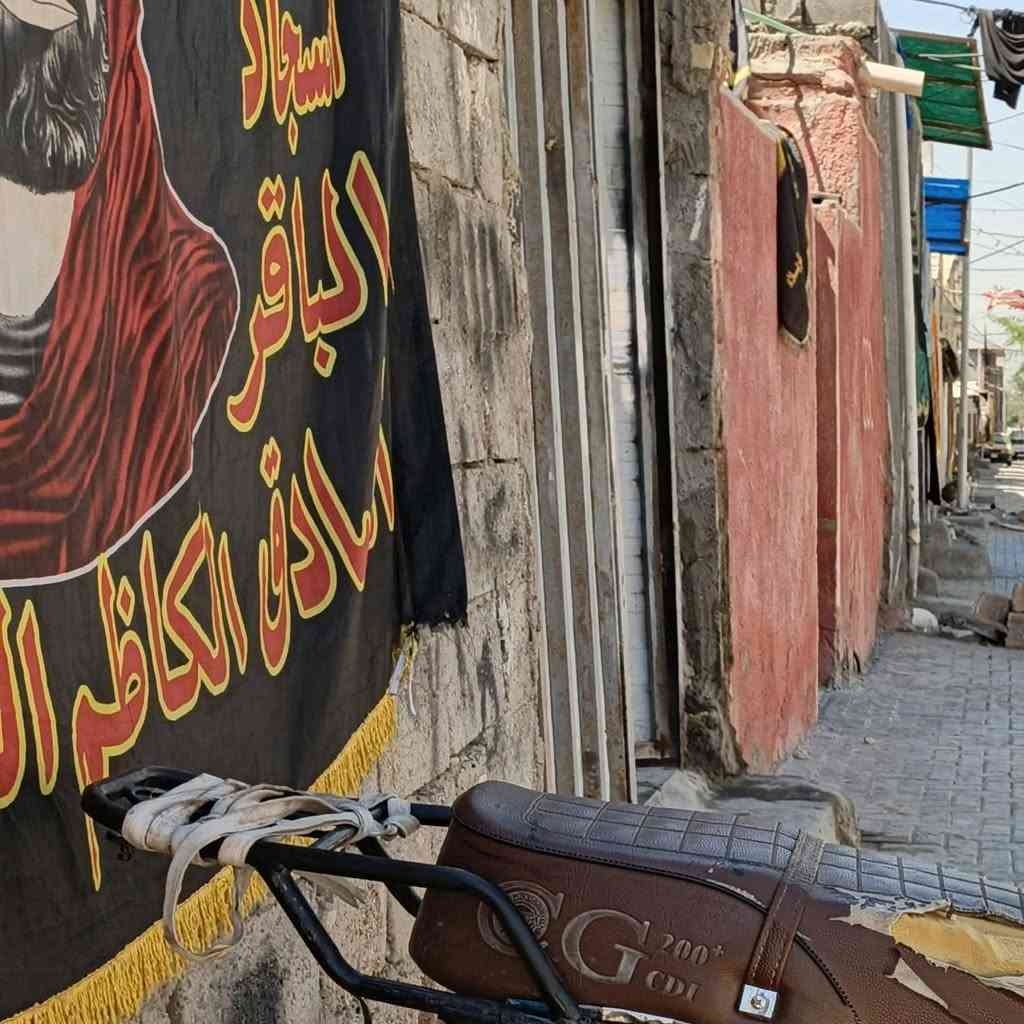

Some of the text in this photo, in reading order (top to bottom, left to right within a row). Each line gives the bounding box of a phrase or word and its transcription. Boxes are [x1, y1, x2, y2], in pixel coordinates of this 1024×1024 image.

[240, 0, 346, 156] اسجاد
[227, 150, 394, 432] الباقر
[73, 511, 248, 891] الكاظم
[646, 970, 702, 1002] CDI
